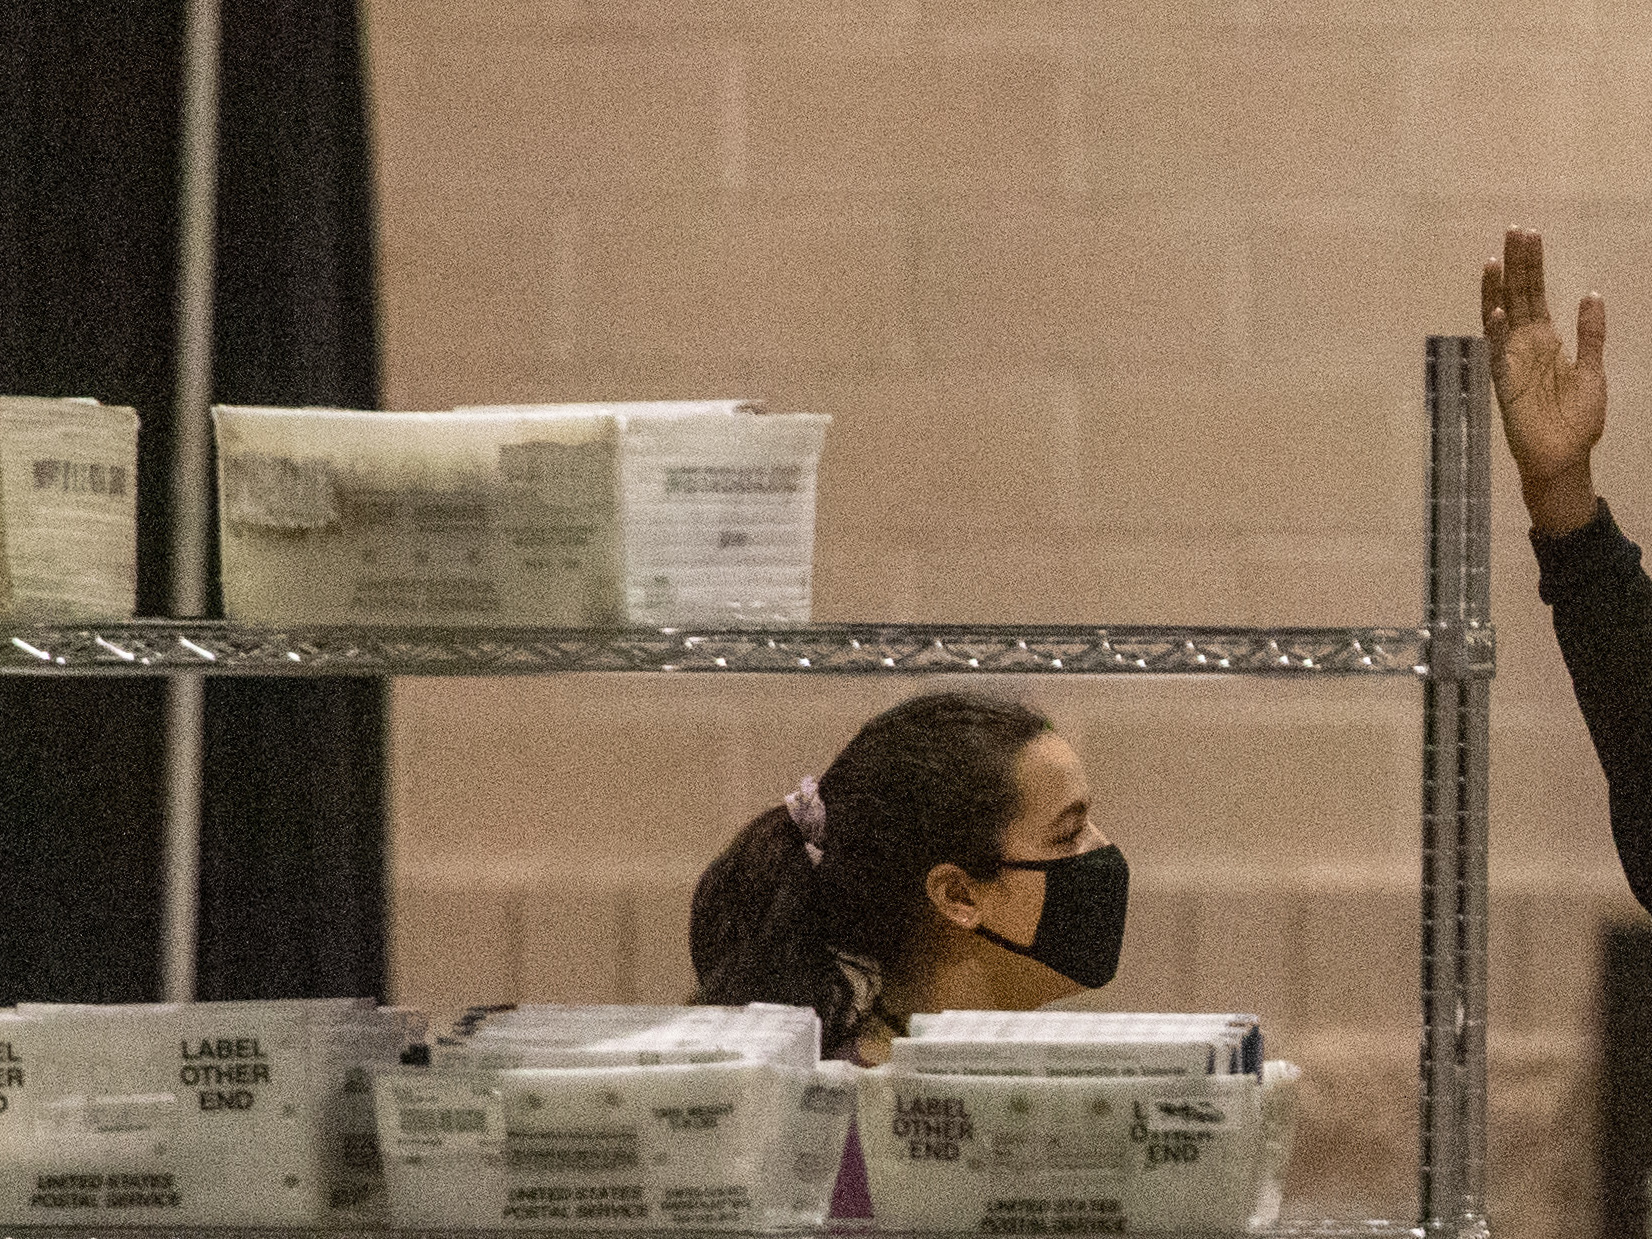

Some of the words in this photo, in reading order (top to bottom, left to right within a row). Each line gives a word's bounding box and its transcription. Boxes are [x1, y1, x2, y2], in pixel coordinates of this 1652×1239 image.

[181, 1039, 267, 1060] LABEL
[180, 1063, 271, 1086] OTHER
[199, 1090, 254, 1111] END
[897, 1098, 970, 1119] LABEL
[893, 1120, 974, 1141] OTHER
[910, 1142, 960, 1162] END
[1148, 1143, 1199, 1164] END
[37, 1174, 102, 1190] UNITED
[105, 1173, 174, 1189] STATES
[30, 1193, 98, 1208] POSTAL
[105, 1192, 181, 1208] SERVICE
[508, 1187, 571, 1200] UNITED
[575, 1186, 643, 1199] STATES
[503, 1205, 569, 1219] POSTAL
[575, 1204, 648, 1218] SERVICE
